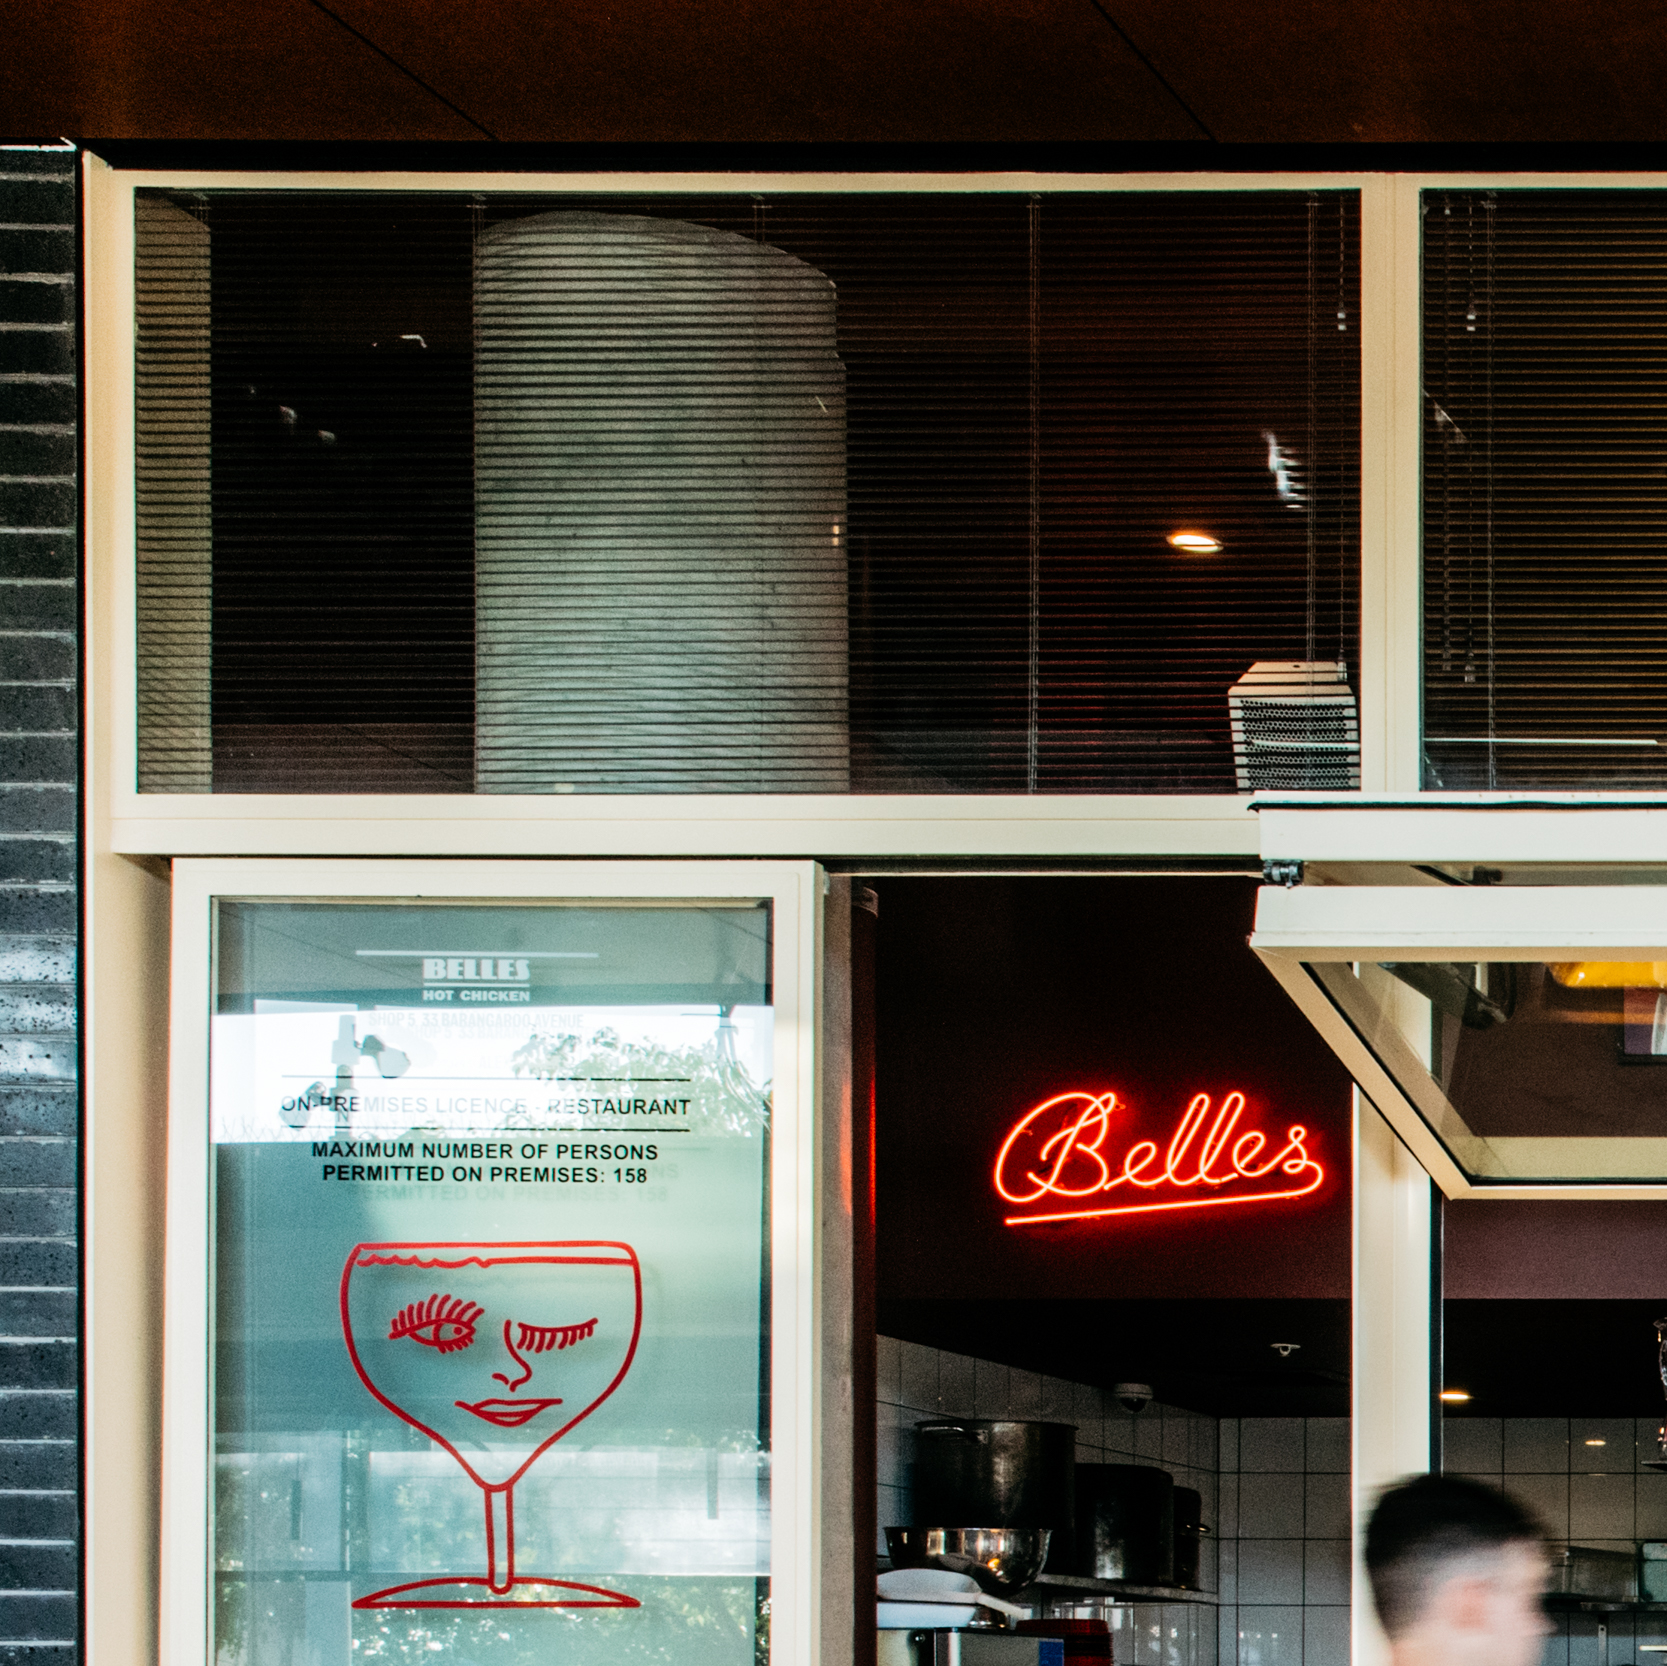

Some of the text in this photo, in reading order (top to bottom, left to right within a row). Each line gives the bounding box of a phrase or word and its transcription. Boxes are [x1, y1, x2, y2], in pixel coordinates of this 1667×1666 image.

[422, 958, 531, 981] BELLES
[422, 990, 531, 1002] HOT CHICKEN
[368, 1012, 405, 1027] SHOP
[421, 1013, 438, 1027] 33
[441, 1013, 530, 1028] BARANGAROO
[535, 1014, 583, 1029] AVENUE
[281, 1095, 428, 1113] ON-PREMISES
[435, 1096, 527, 1115] LICENCE
[549, 1098, 692, 1116] RESTAURANT
[311, 1141, 659, 1162] MAXIMUM NUMBER OF PERSONS
[993, 1090, 1324, 1226] Belles
[322, 1165, 649, 1184] PERMITTED ON PREMISES: 158
